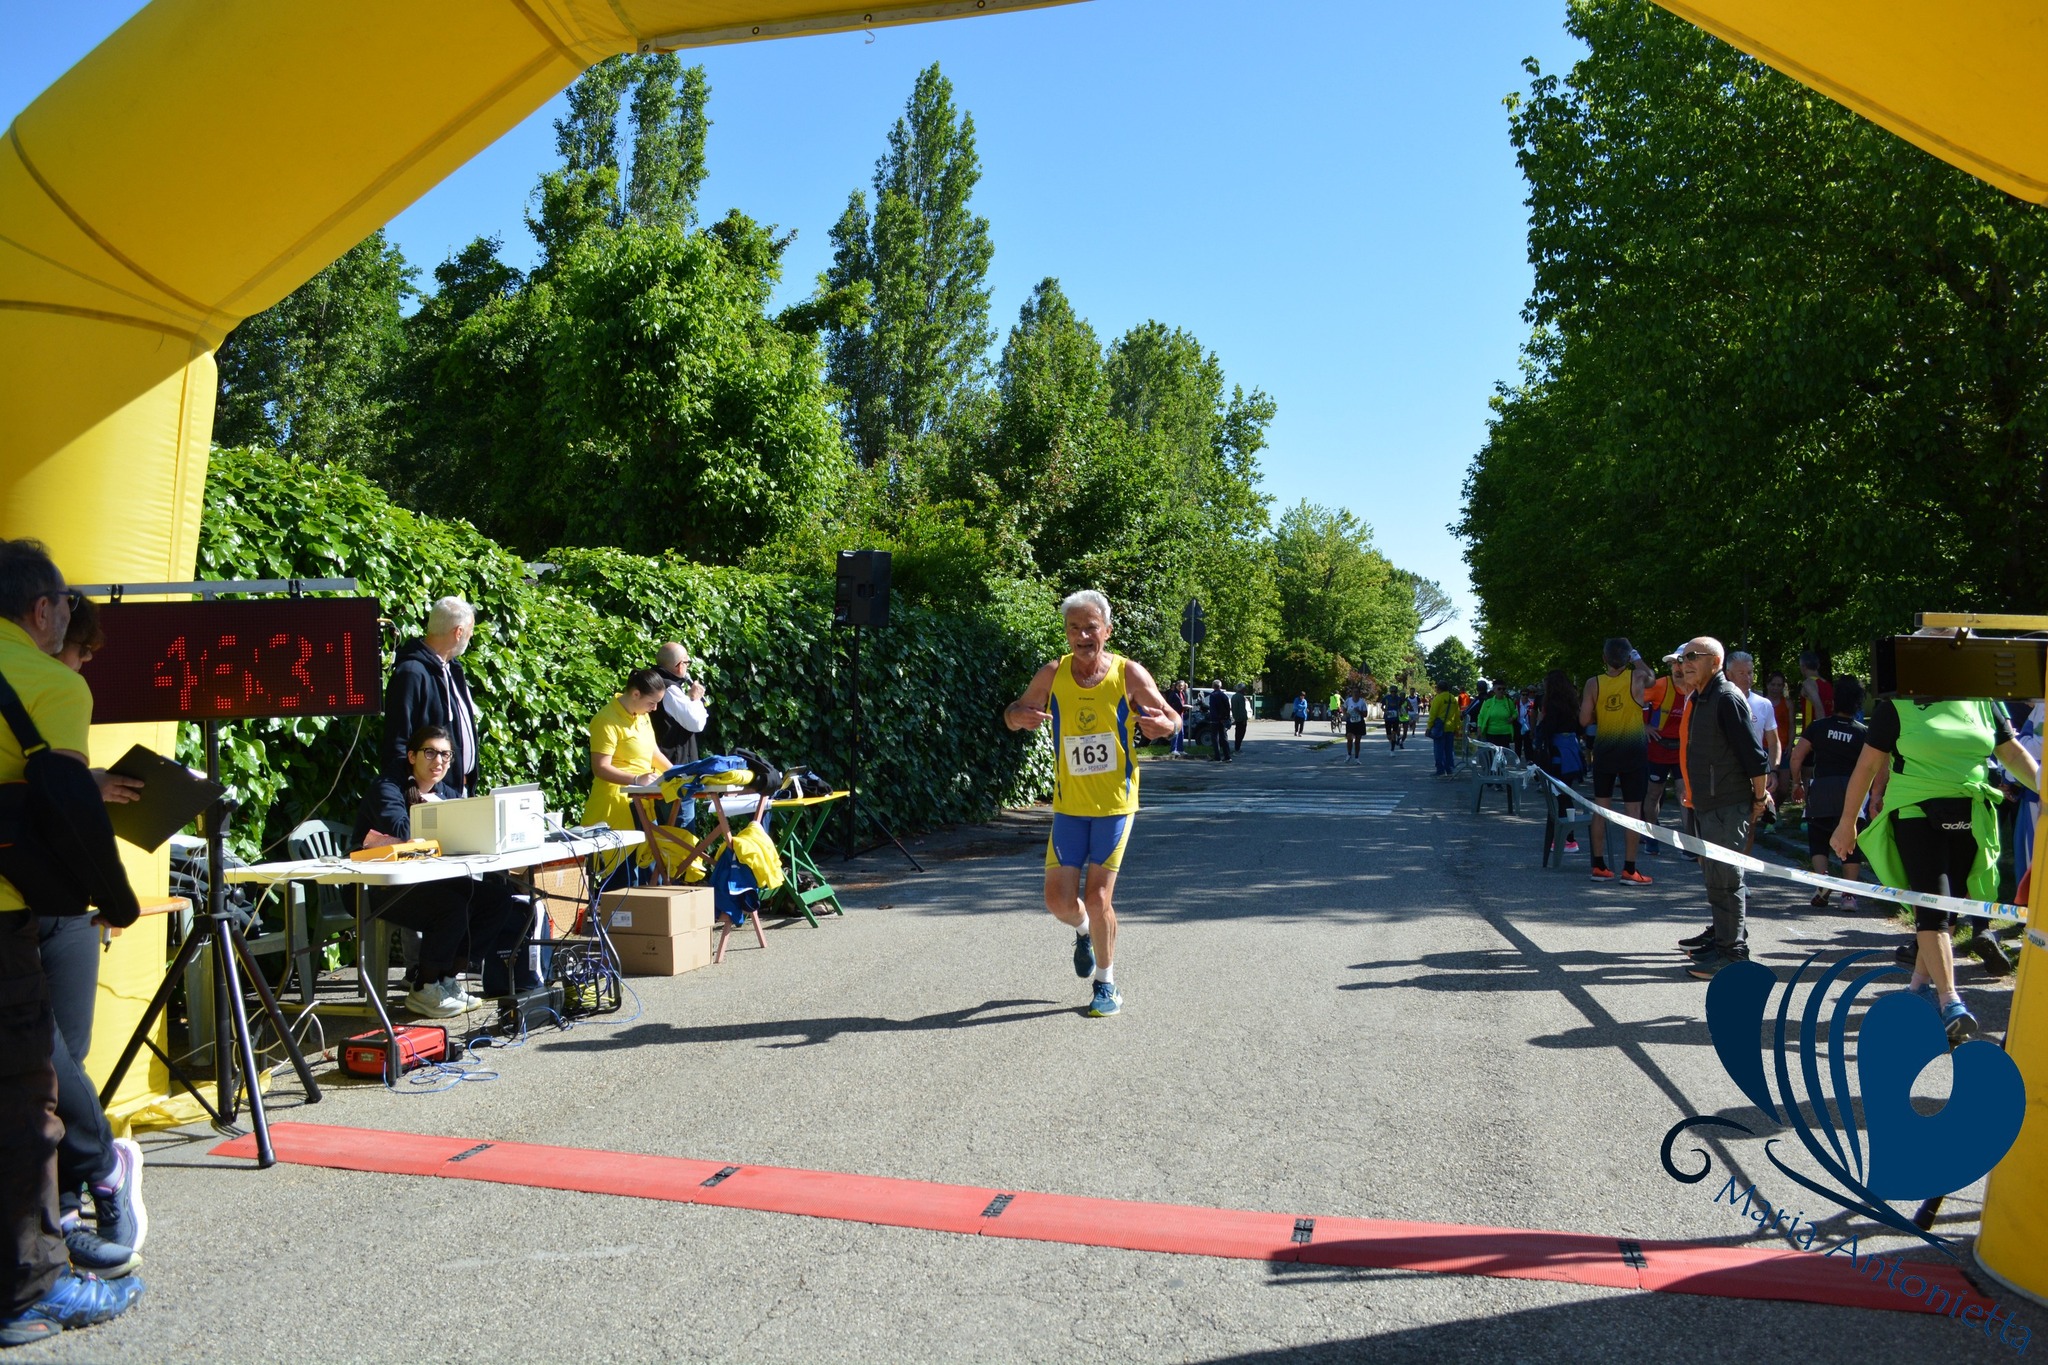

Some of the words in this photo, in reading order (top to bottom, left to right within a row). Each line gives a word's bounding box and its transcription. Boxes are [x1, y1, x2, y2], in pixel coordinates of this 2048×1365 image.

[1827, 729, 1853, 743] PATTY
[1072, 743, 1108, 766] 163
[1941, 821, 1973, 830] adid
